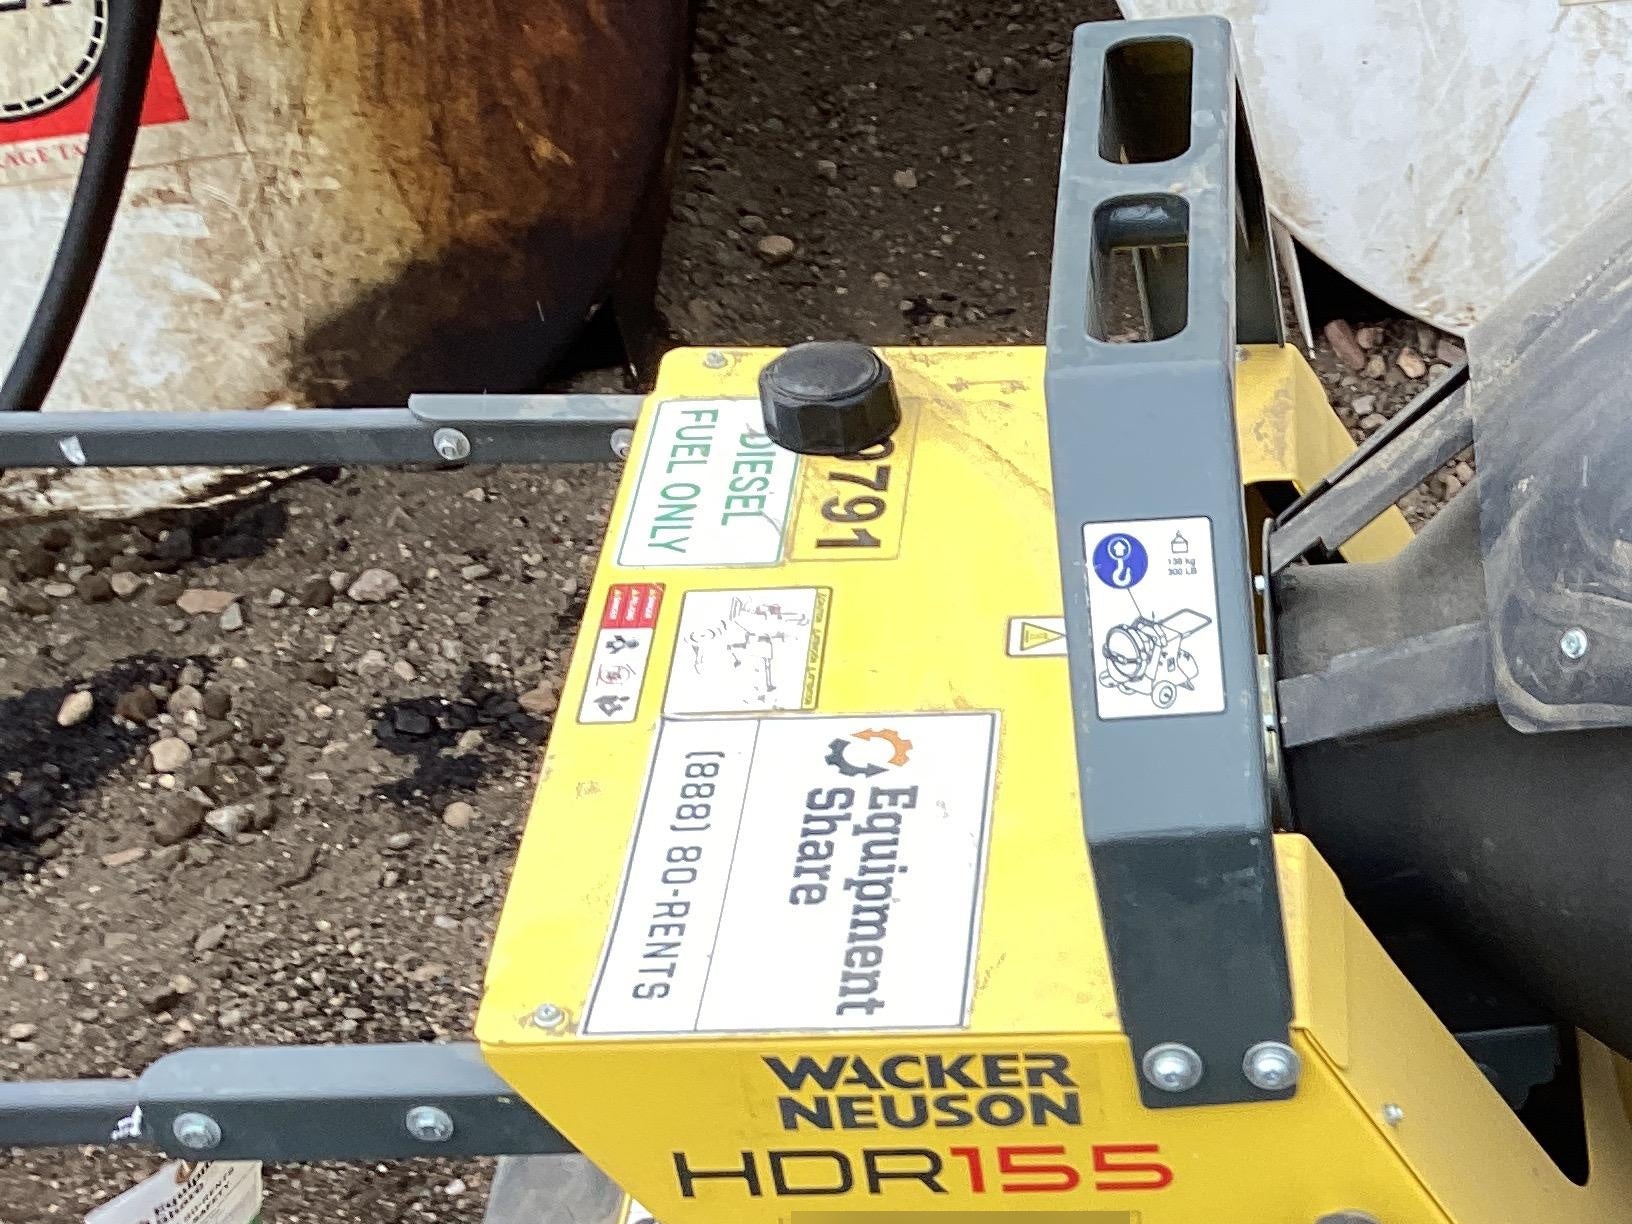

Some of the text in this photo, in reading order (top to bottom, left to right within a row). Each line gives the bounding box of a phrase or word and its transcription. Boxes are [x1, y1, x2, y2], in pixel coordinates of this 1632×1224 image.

[0, 147, 49, 168] AGE
[648, 409, 719, 553] FUEL ONLY
[721, 433, 776, 526] DIESEL
[632, 751, 725, 999] (888) 80-RENTS
[789, 787, 855, 905] Share
[836, 785, 918, 1015] Equipment
[763, 1052, 1080, 1090] WACKER
[777, 1092, 1082, 1131] NEUSON
[672, 1144, 1174, 1198] HDR155
